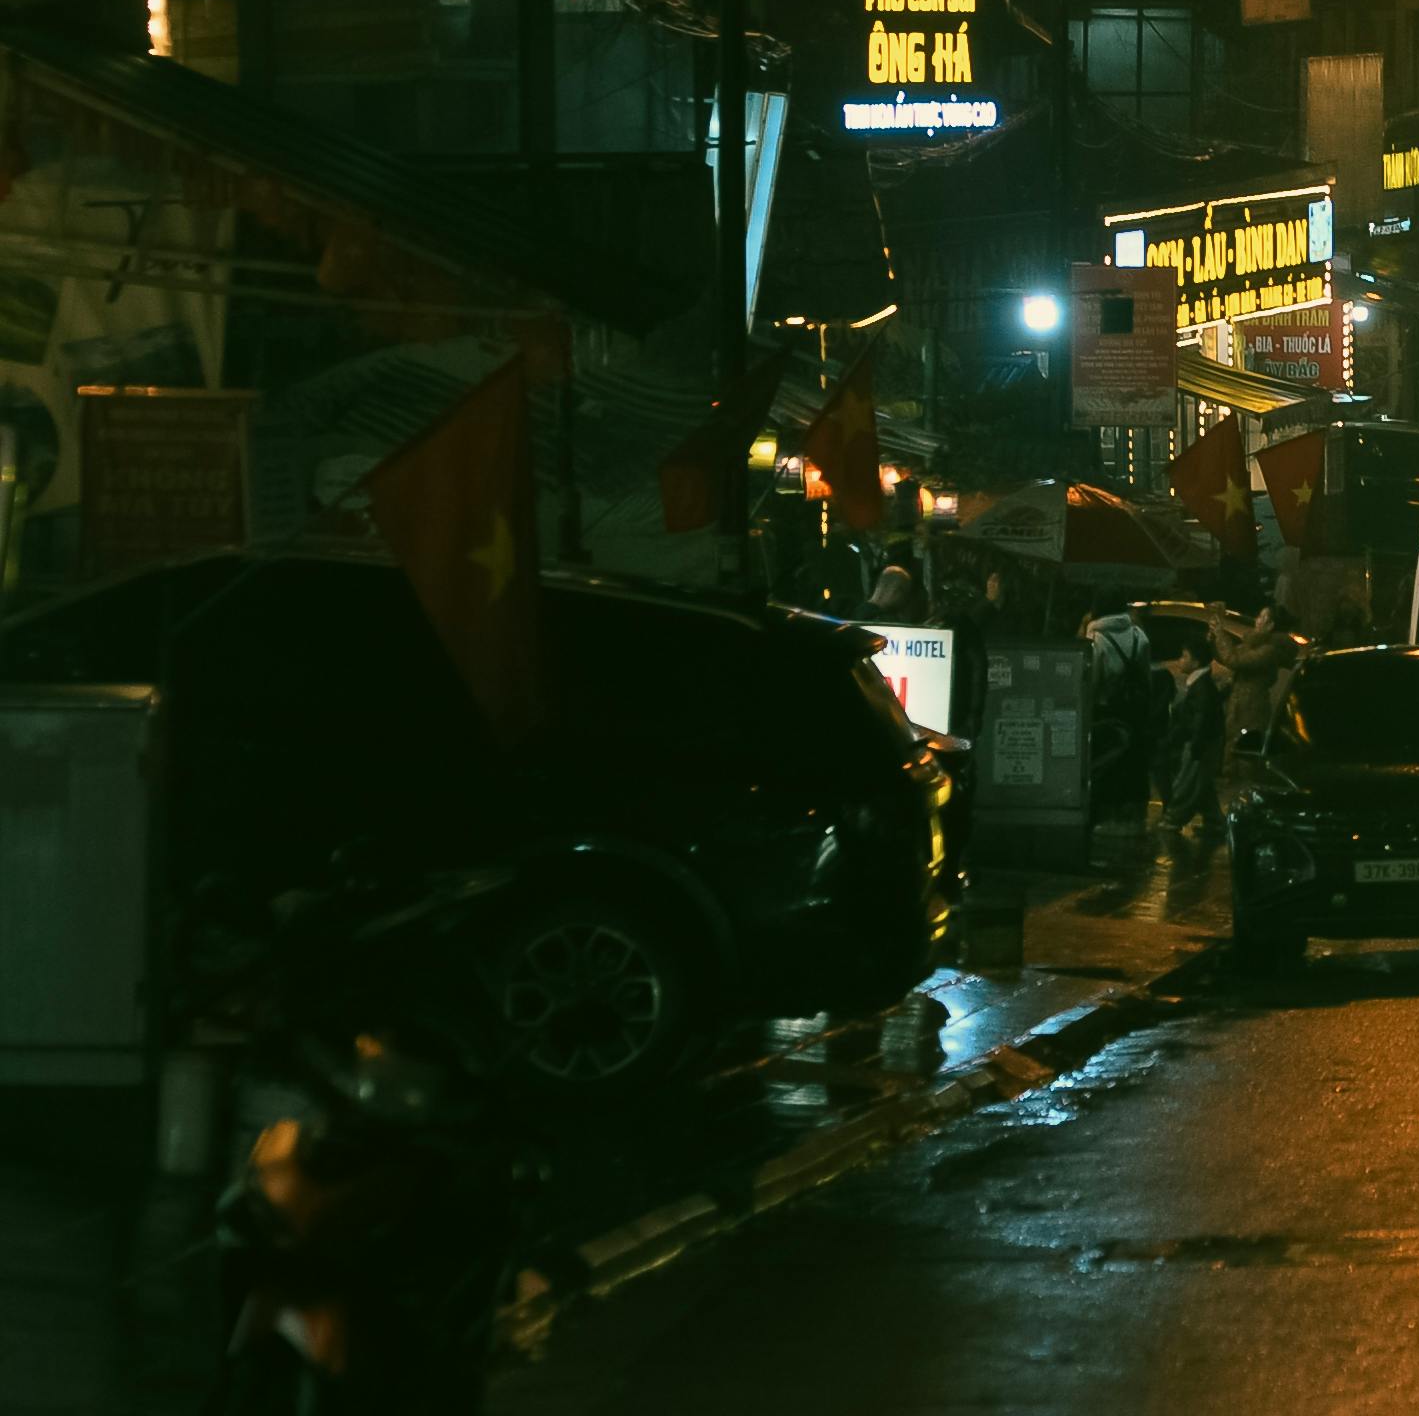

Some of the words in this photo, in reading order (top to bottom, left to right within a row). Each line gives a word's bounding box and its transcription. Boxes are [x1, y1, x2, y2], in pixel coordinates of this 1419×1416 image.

[868, 20, 926, 84] ÔNG
[1235, 207, 1274, 276] BÌNH
[1255, 335, 1273, 353] BIA
[1282, 330, 1316, 354] THUỐC
[905, 637, 946, 659] HOTEL
